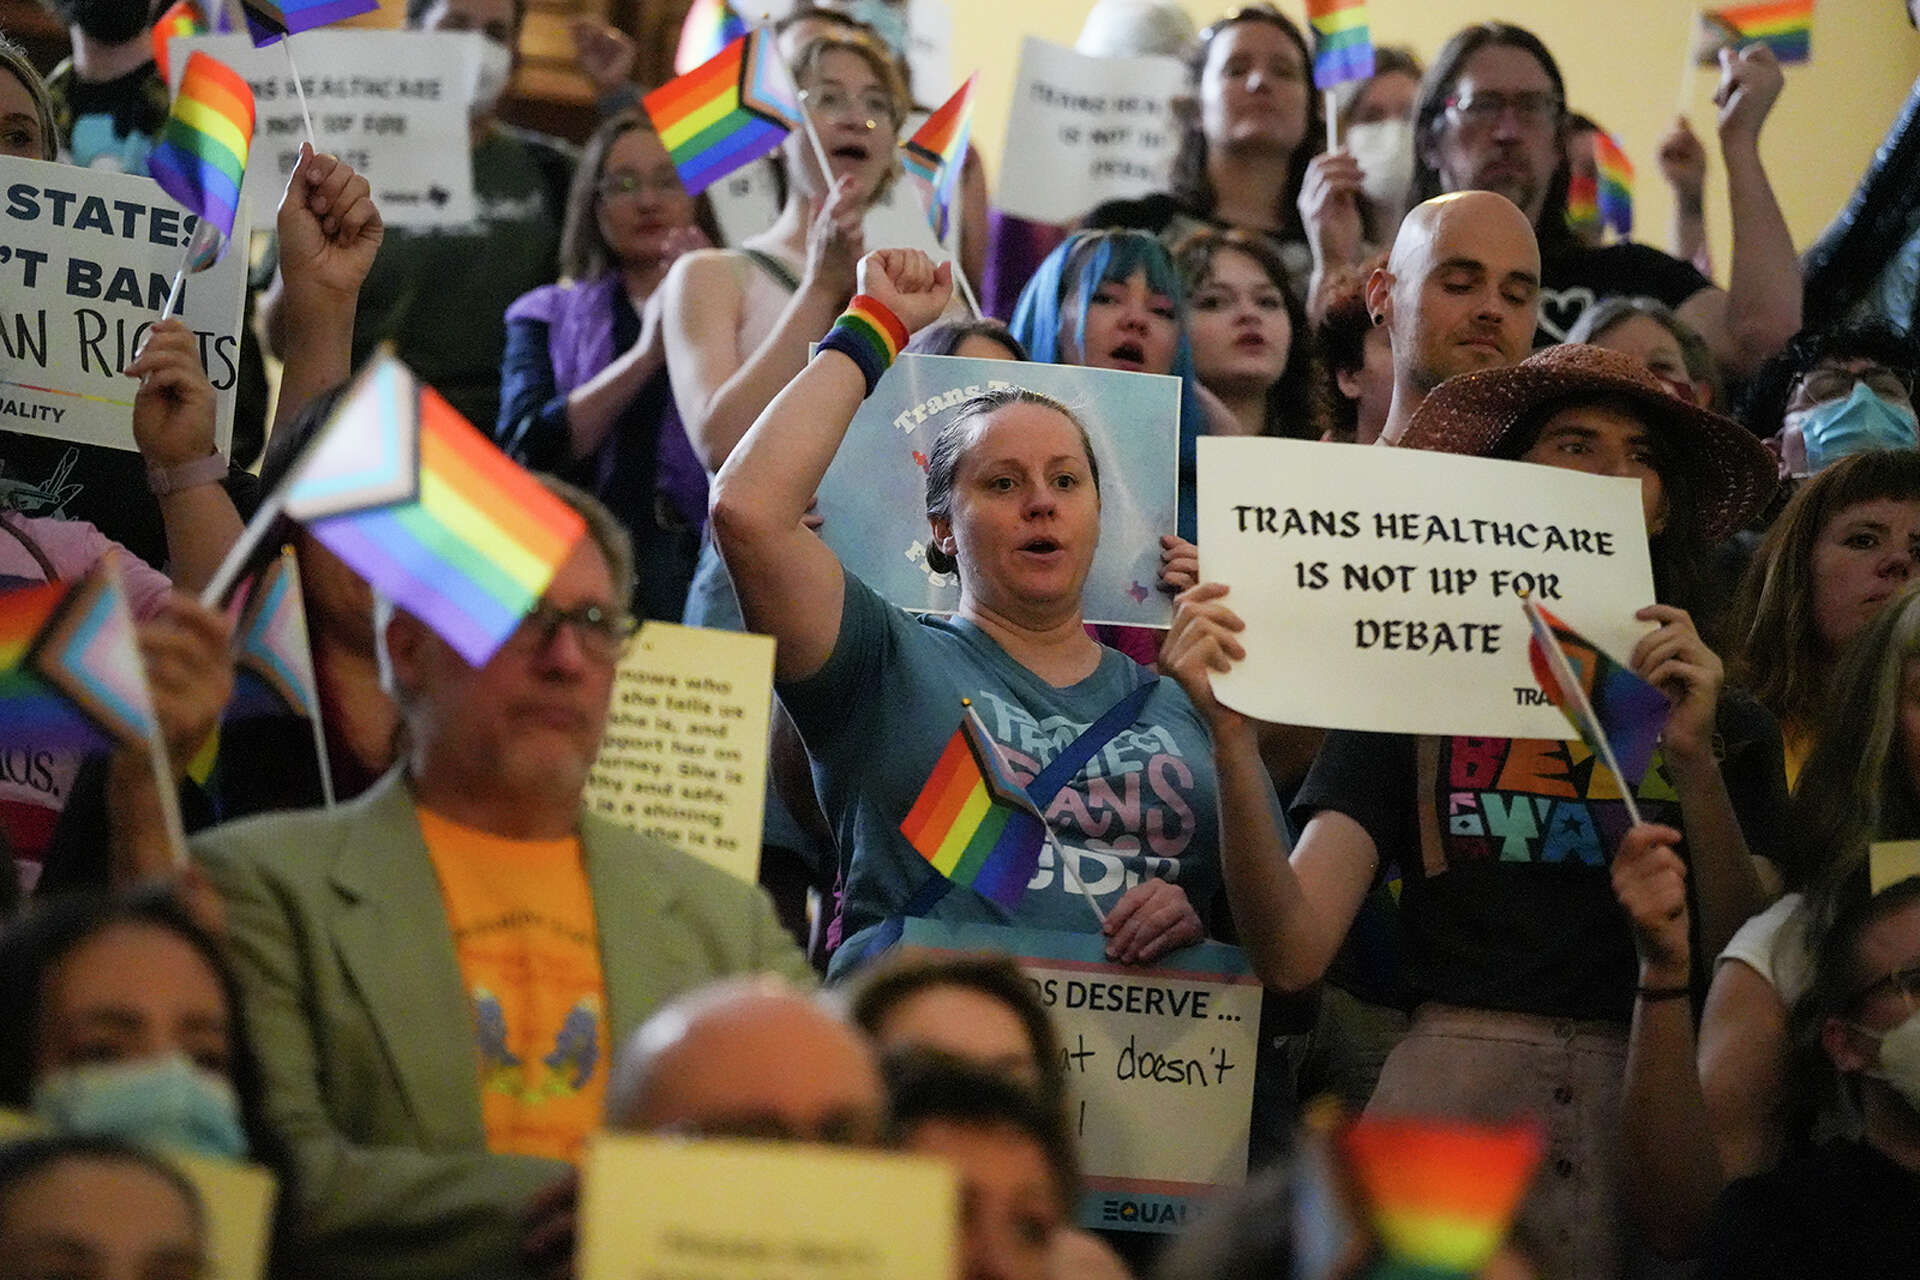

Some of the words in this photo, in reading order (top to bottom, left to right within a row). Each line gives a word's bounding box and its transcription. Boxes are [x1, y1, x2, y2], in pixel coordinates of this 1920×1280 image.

[6, 183, 199, 248] STATES
[66, 257, 187, 315] BAN
[73, 308, 237, 391] RITS
[0, 398, 66, 423] ALITY
[1232, 504, 1361, 539] TRANS
[1374, 512, 1617, 556] HEALTHCARE
[1296, 561, 1329, 590] IS
[1344, 563, 1417, 594] NOT
[1430, 567, 1477, 597] UP
[1490, 570, 1563, 601] FOR
[1355, 619, 1503, 655] DEBATE
[1513, 687, 1557, 706] TRA
[1117, 1034, 1235, 1086] doesn't
